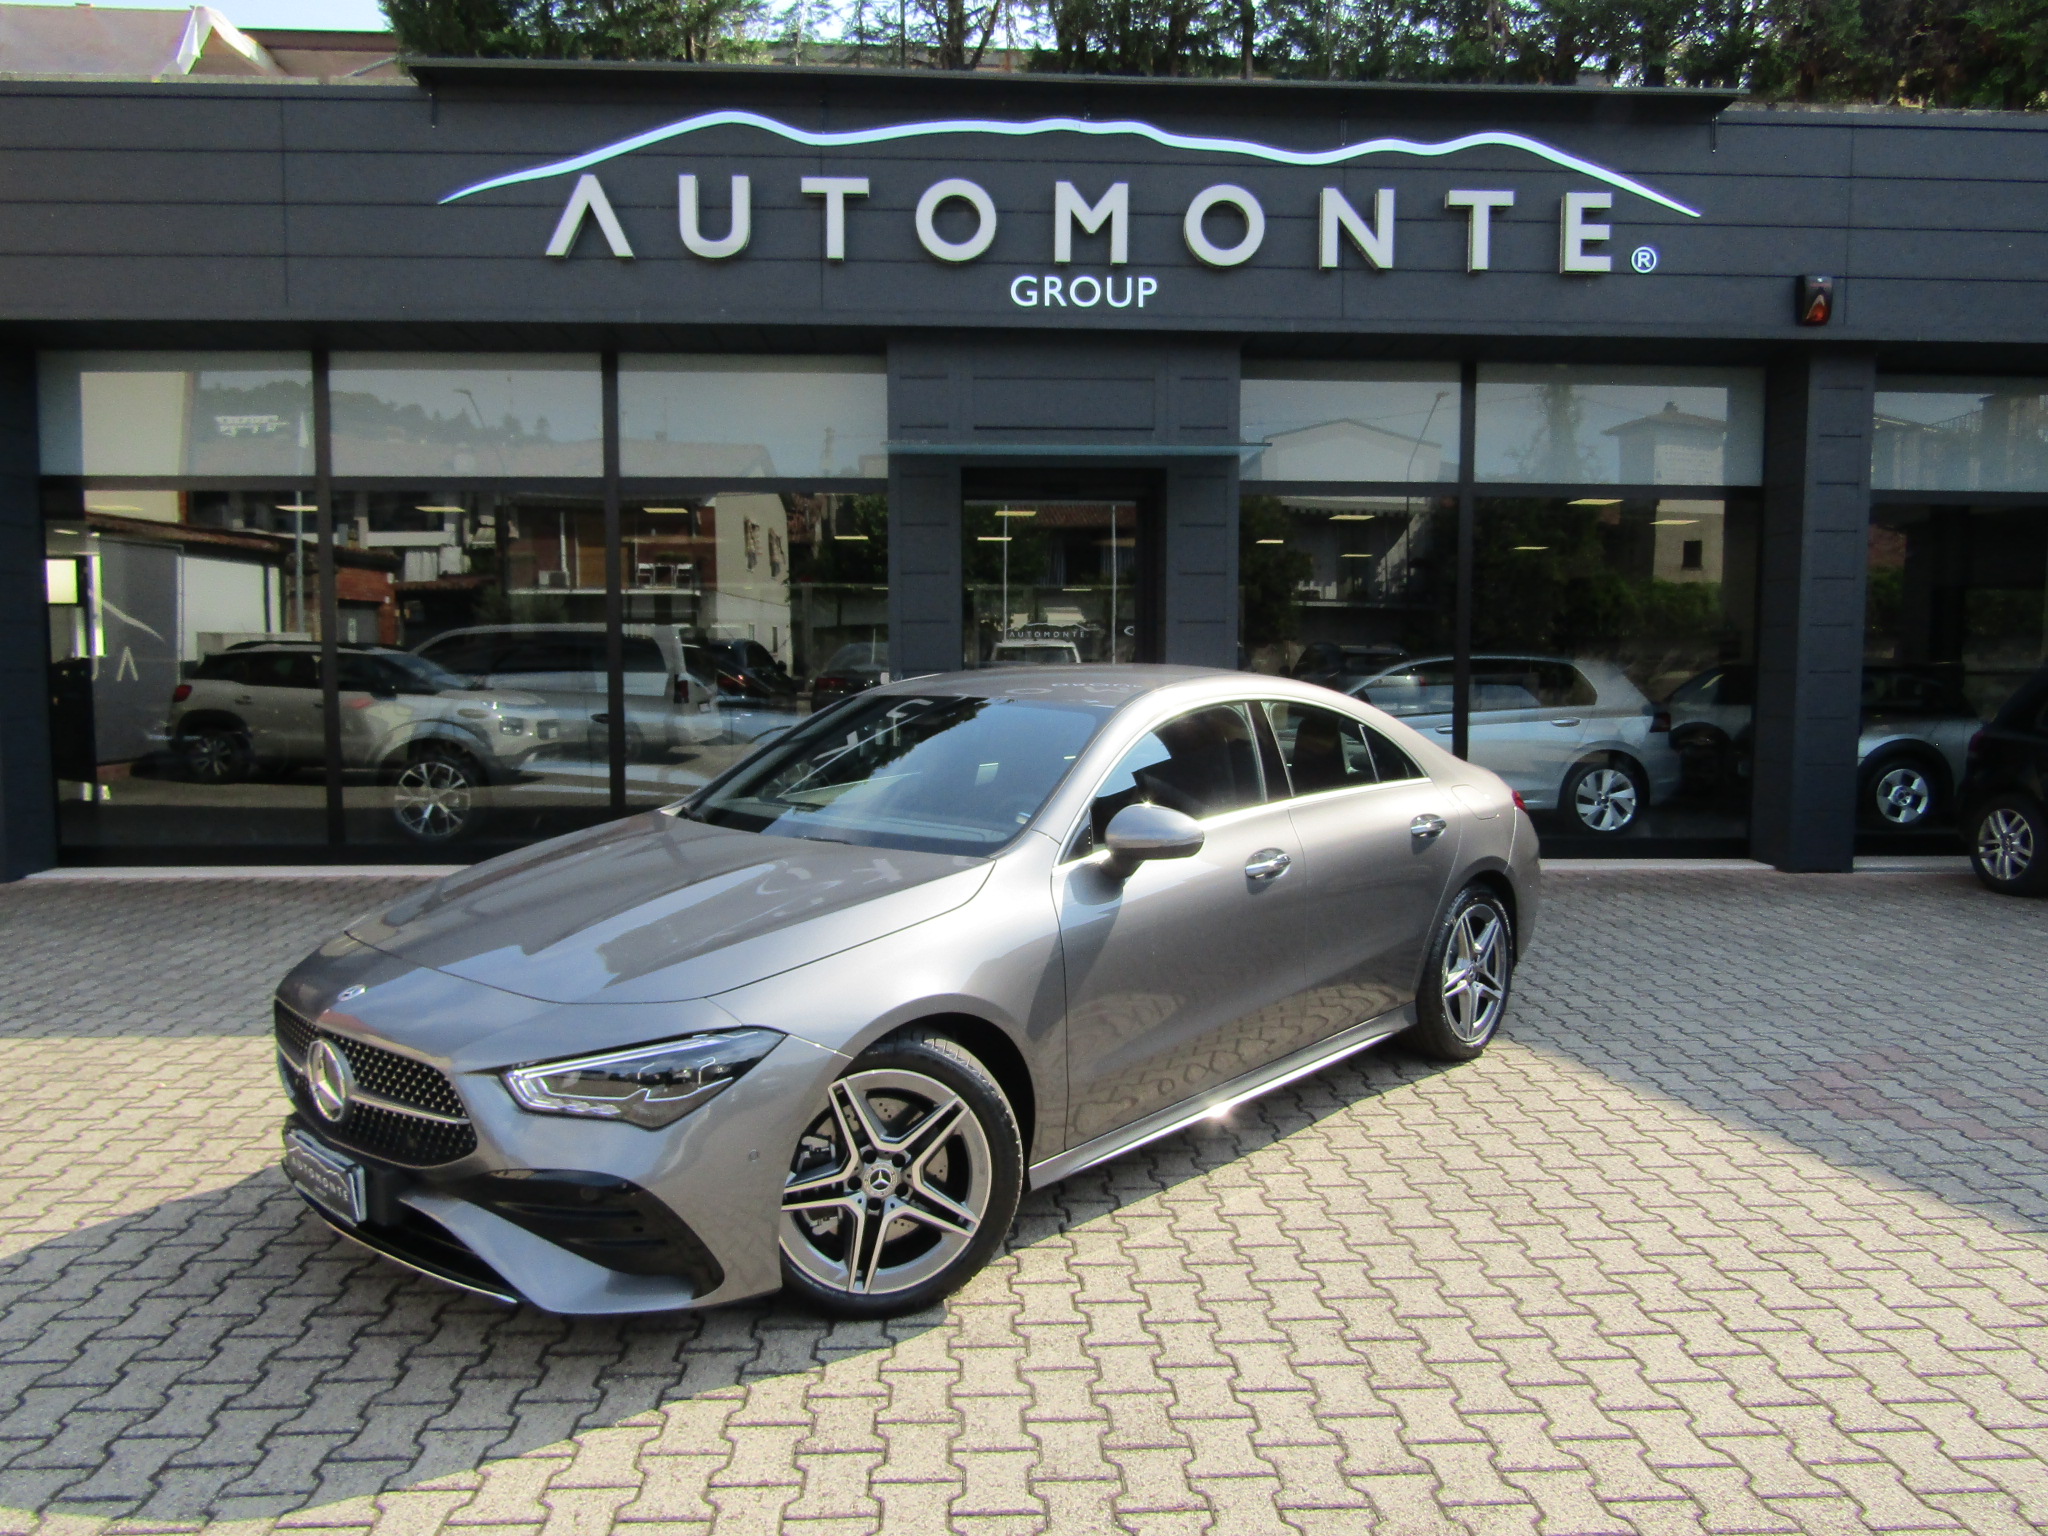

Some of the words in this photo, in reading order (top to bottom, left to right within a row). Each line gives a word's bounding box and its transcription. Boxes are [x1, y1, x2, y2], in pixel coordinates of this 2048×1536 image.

[545, 173, 1613, 275] AUTOMONTE
[1010, 275, 1158, 308] GROUP
[1009, 630, 1085, 639] AUTOMONTE
